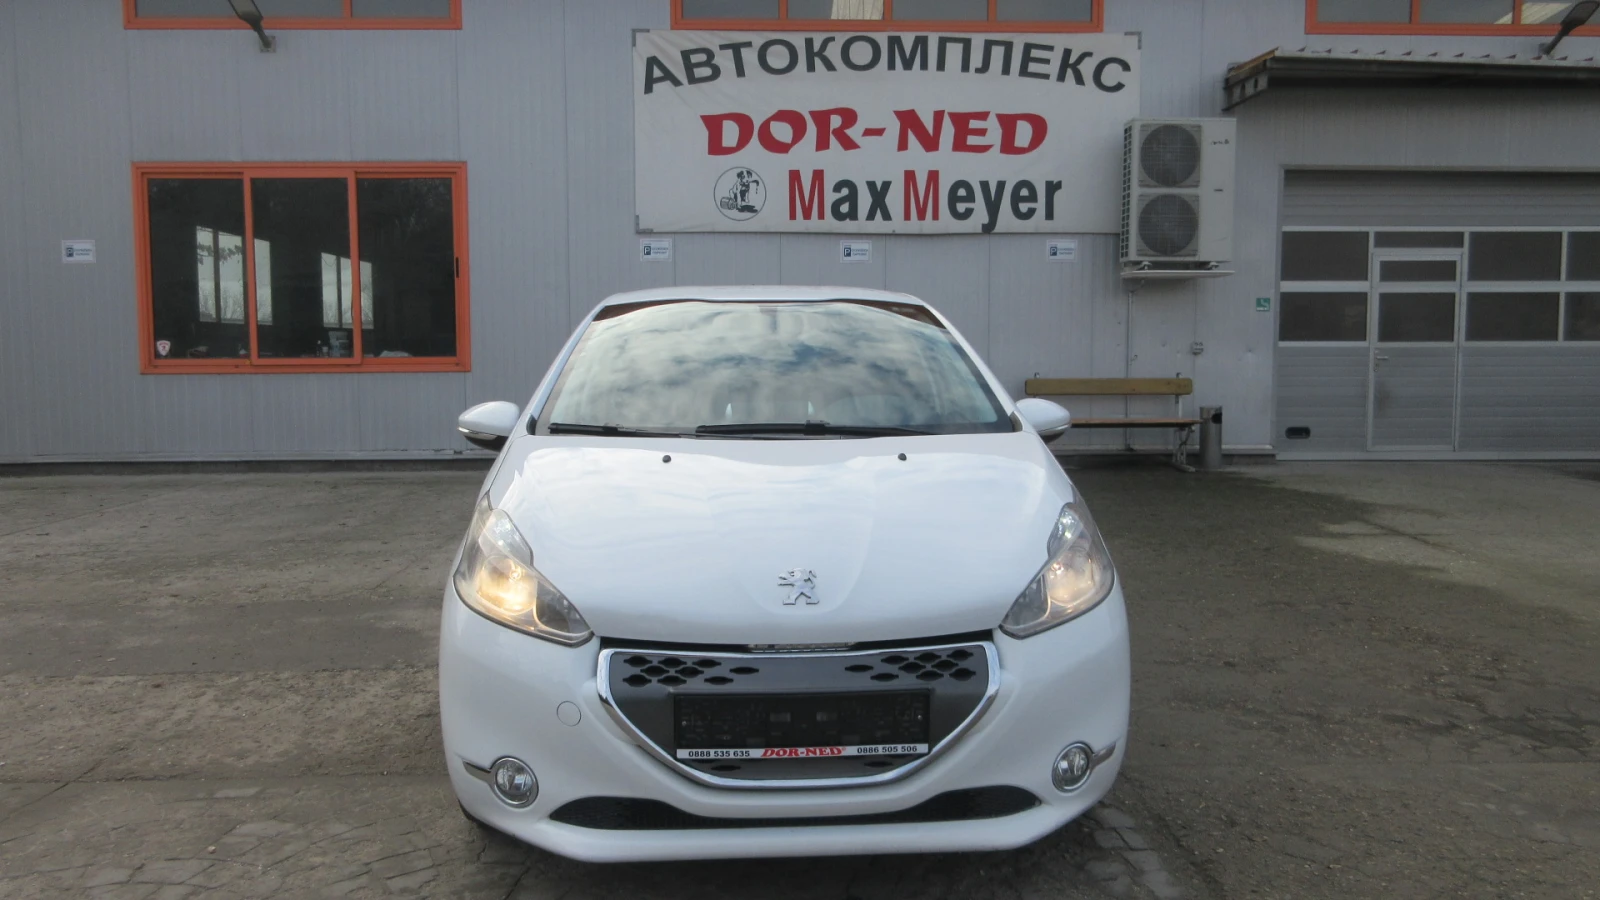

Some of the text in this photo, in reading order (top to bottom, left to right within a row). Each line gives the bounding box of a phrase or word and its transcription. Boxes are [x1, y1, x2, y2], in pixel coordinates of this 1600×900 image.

[643, 35, 1132, 94] АВТОКОМПЛЕКС
[700, 107, 1048, 156] DOR-NED
[857, 746, 879, 754] 0886
[901, 745, 918, 753] 506
